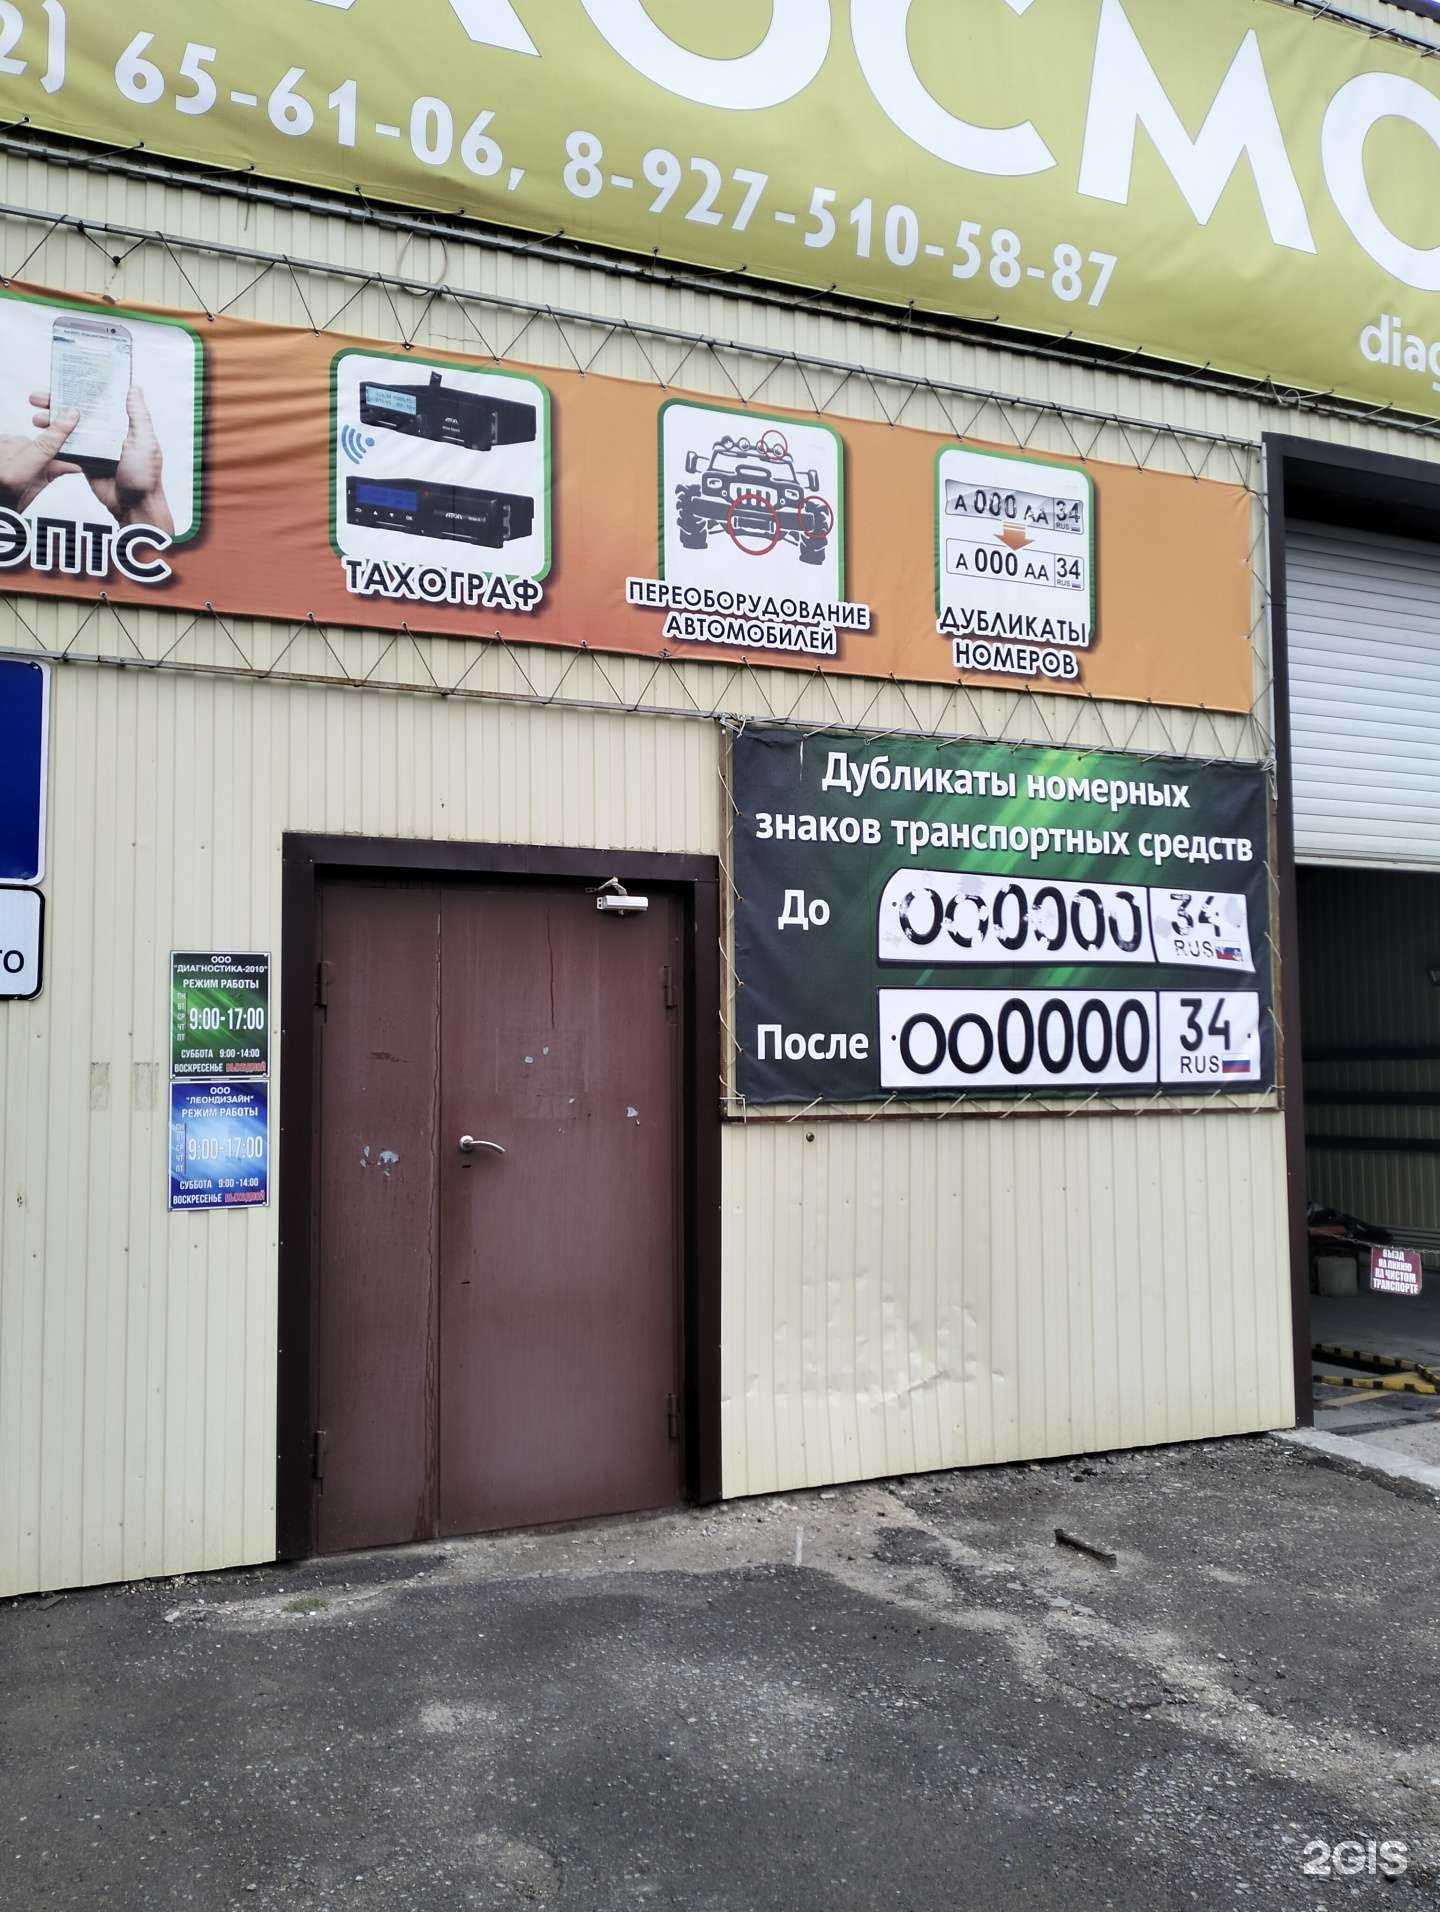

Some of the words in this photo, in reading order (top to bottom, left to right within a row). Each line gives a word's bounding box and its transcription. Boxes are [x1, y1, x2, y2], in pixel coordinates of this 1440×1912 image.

[114, 31, 526, 191] 65-61-06,
[562, 130, 1117, 307] 8-927-510-58-87
[1056, 500, 1080, 523] 34
[0, 510, 168, 578] ЭПТС
[1056, 557, 1081, 580] 34
[346, 559, 539, 607] ТАХОГРАФ
[629, 581, 867, 625] ПЕРЕОБОРУДОВАНИЕ
[666, 616, 834, 651] АВТОМОБИЛЕЙ
[939, 606, 1086, 644] ДУБЛИКАТЫ
[956, 642, 1075, 675] НОМЕРОВ
[822, 751, 1016, 797] Дубликаты
[1027, 773, 1191, 812] номерных
[755, 812, 882, 845] знаков
[891, 818, 1130, 860] транспортных
[1138, 831, 1254, 866] средств
[778, 889, 830, 930] До
[211, 956, 232, 964] ООО
[1174, 939, 1214, 958] RUS
[174, 964, 268, 973] "ДИАГНОСТИКА-2010"
[183, 979, 218, 989] РЕЖИМ
[221, 979, 259, 989] РАБОТЫ
[1180, 998, 1230, 1051] 34
[181, 1049, 213, 1058] СУББОТА
[757, 1024, 869, 1060] После
[174, 1063, 223, 1072] ВОСКРЕСЕНЬЕ
[1180, 1055, 1219, 1074] RUS
[210, 1086, 231, 1095] ООО
[182, 1108, 217, 1118] РЕЖИМ
[220, 1106, 258, 1117] РАБОТЫ
[180, 1180, 212, 1190] СУББОТА
[173, 1194, 222, 1204] ВОСКРЕСЕНЬЕ
